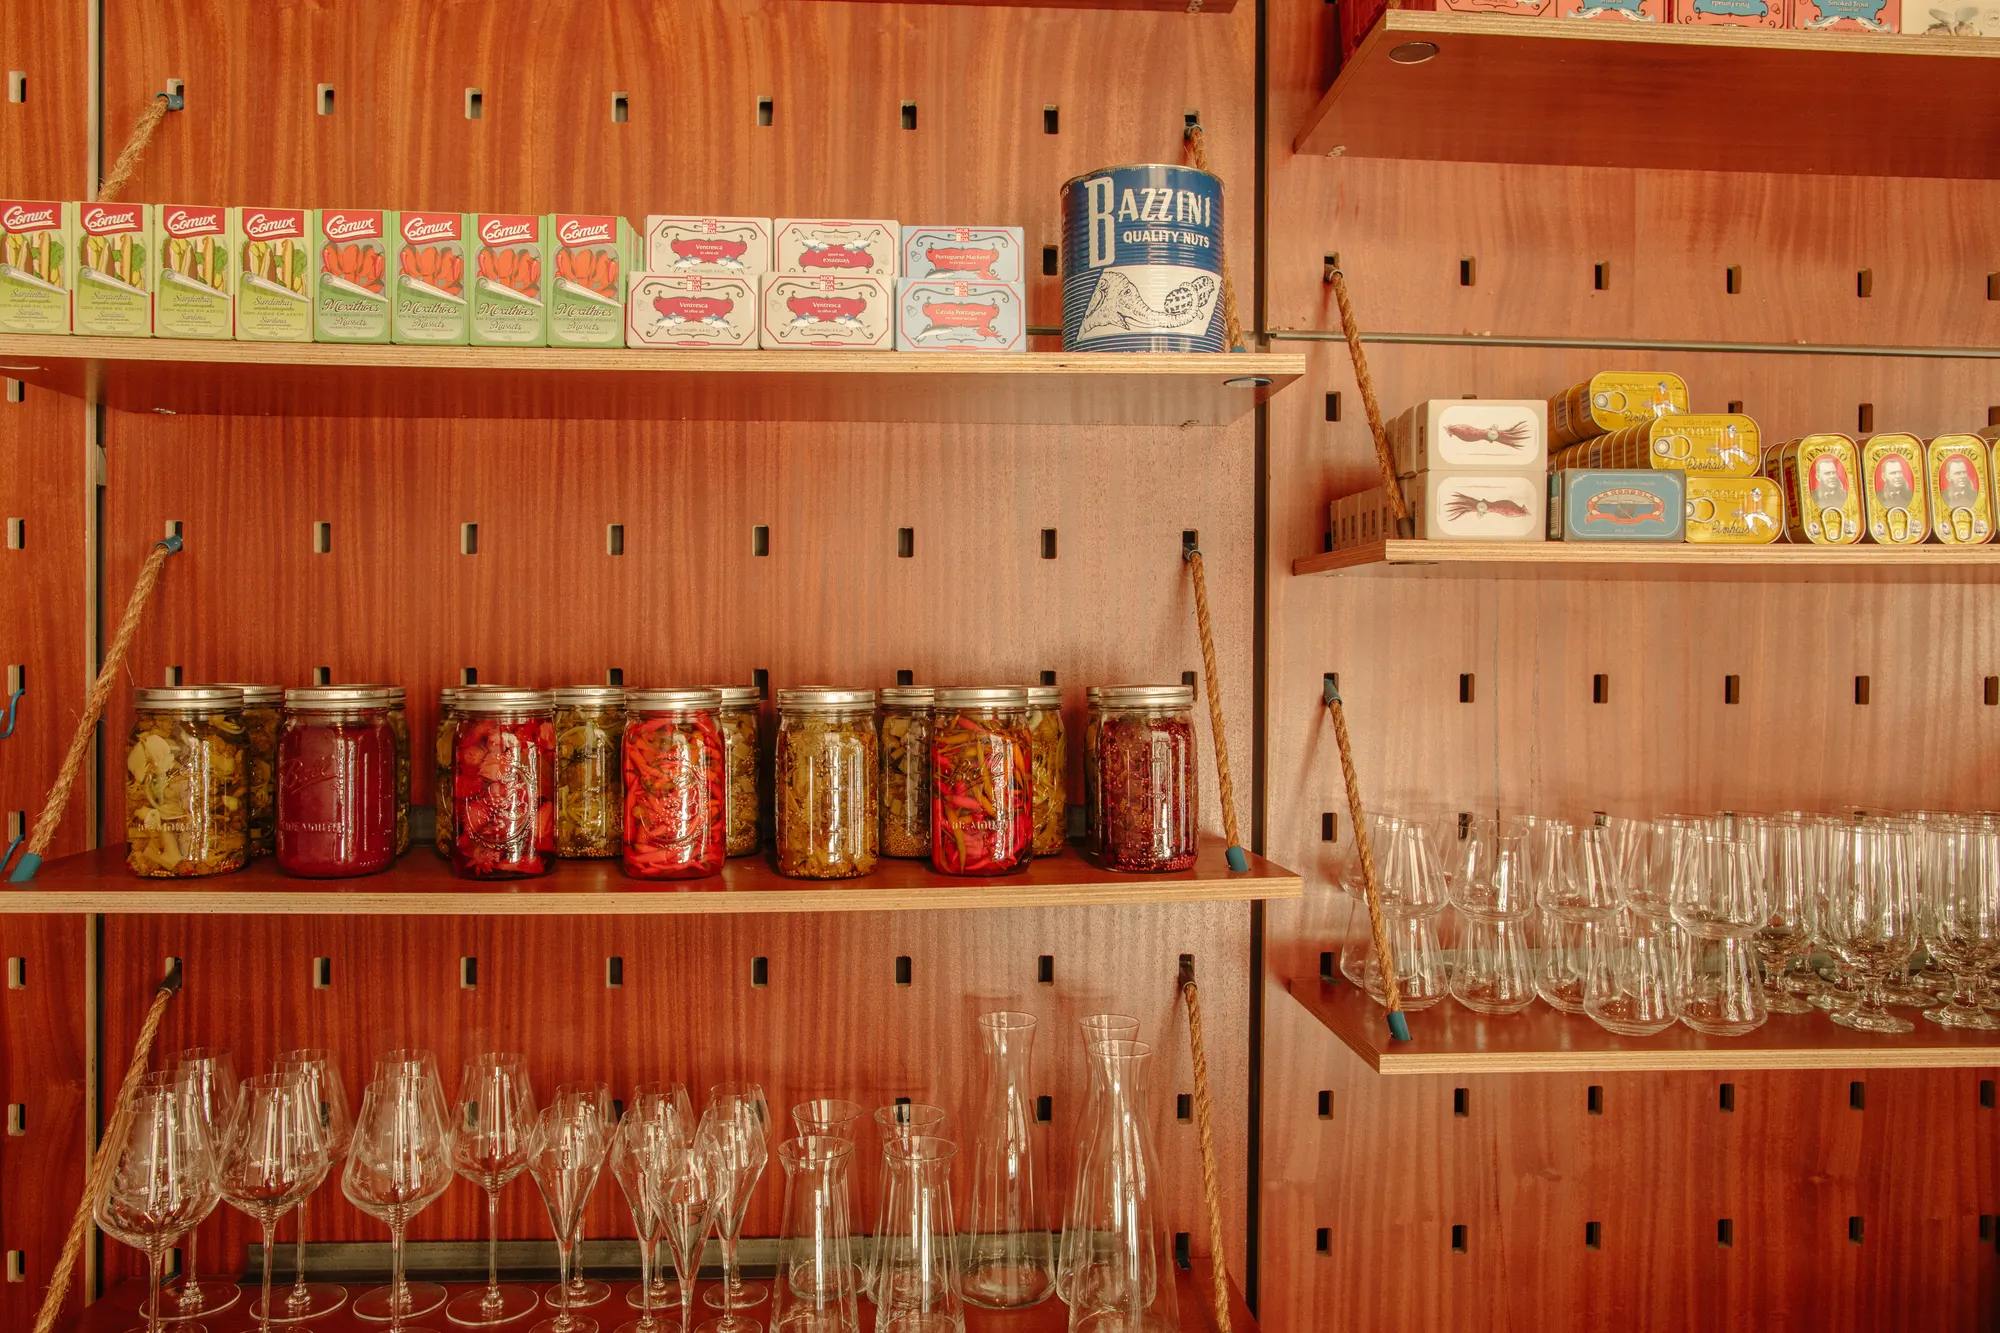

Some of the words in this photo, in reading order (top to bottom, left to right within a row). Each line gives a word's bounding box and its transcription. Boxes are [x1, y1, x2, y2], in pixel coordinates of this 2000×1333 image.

[1084, 176, 1211, 269] BAZZINI
[1123, 230, 1179, 245] QUALITY
[1183, 232, 1210, 249] NUTS
[1807, 445, 1848, 462] TENORIO
[1872, 444, 1914, 462] TENORIO
[1936, 446, 1979, 462] TENORIO
